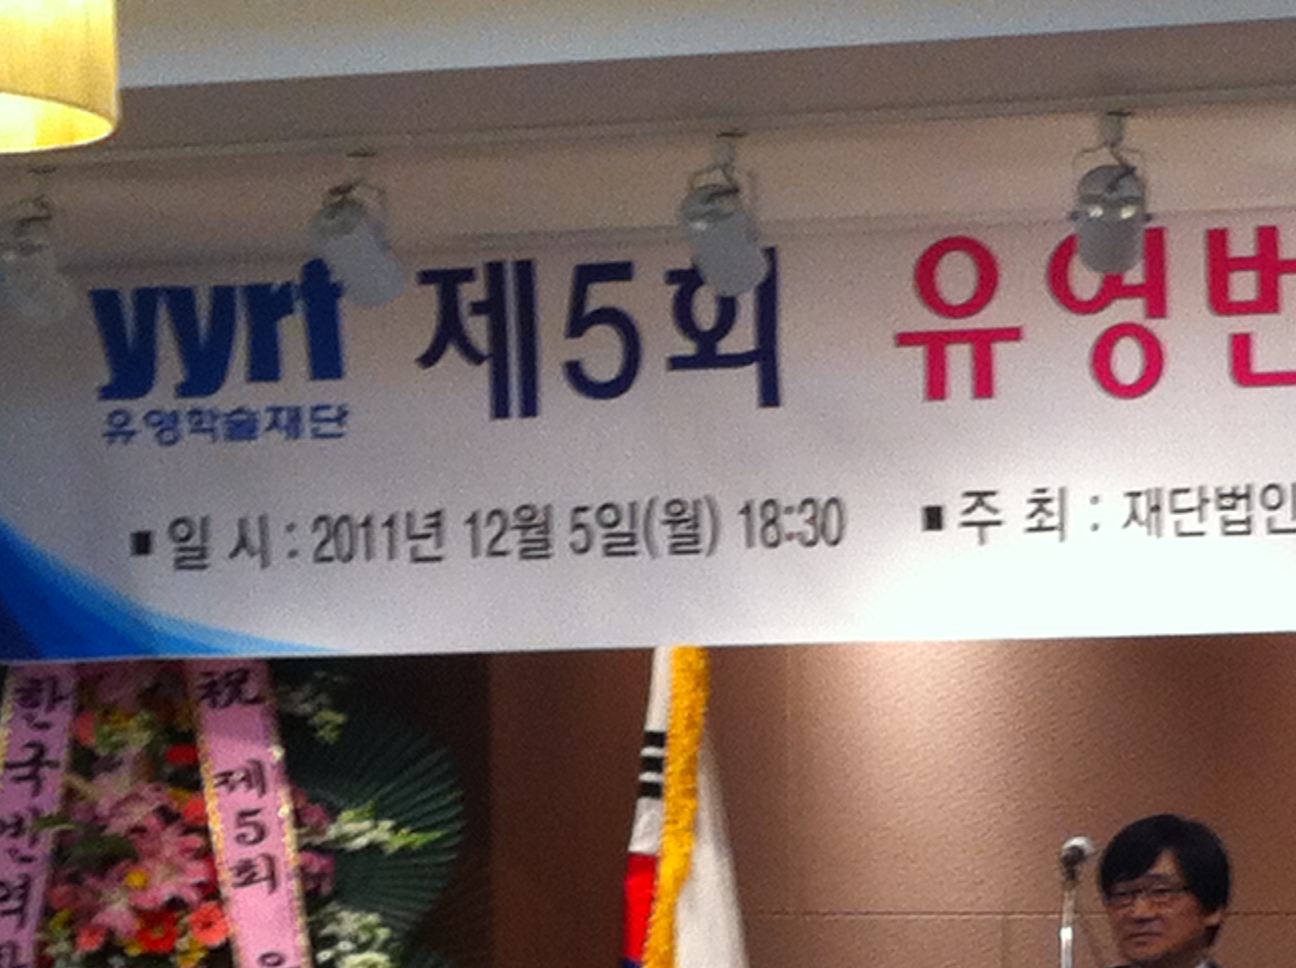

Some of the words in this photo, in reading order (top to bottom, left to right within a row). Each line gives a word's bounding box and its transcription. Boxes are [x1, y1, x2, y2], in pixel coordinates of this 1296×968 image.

[88, 258, 347, 401] yyrt
[415, 246, 783, 421] 제5회
[102, 404, 349, 447] 유영학술재단
[167, 516, 210, 571] 일
[312, 509, 445, 563] 2011년
[464, 503, 555, 562] 12월
[570, 496, 720, 559] 5일(월)
[739, 497, 846, 549] 18:30
[958, 490, 1004, 544] 주
[213, 759, 281, 895] 제5회
